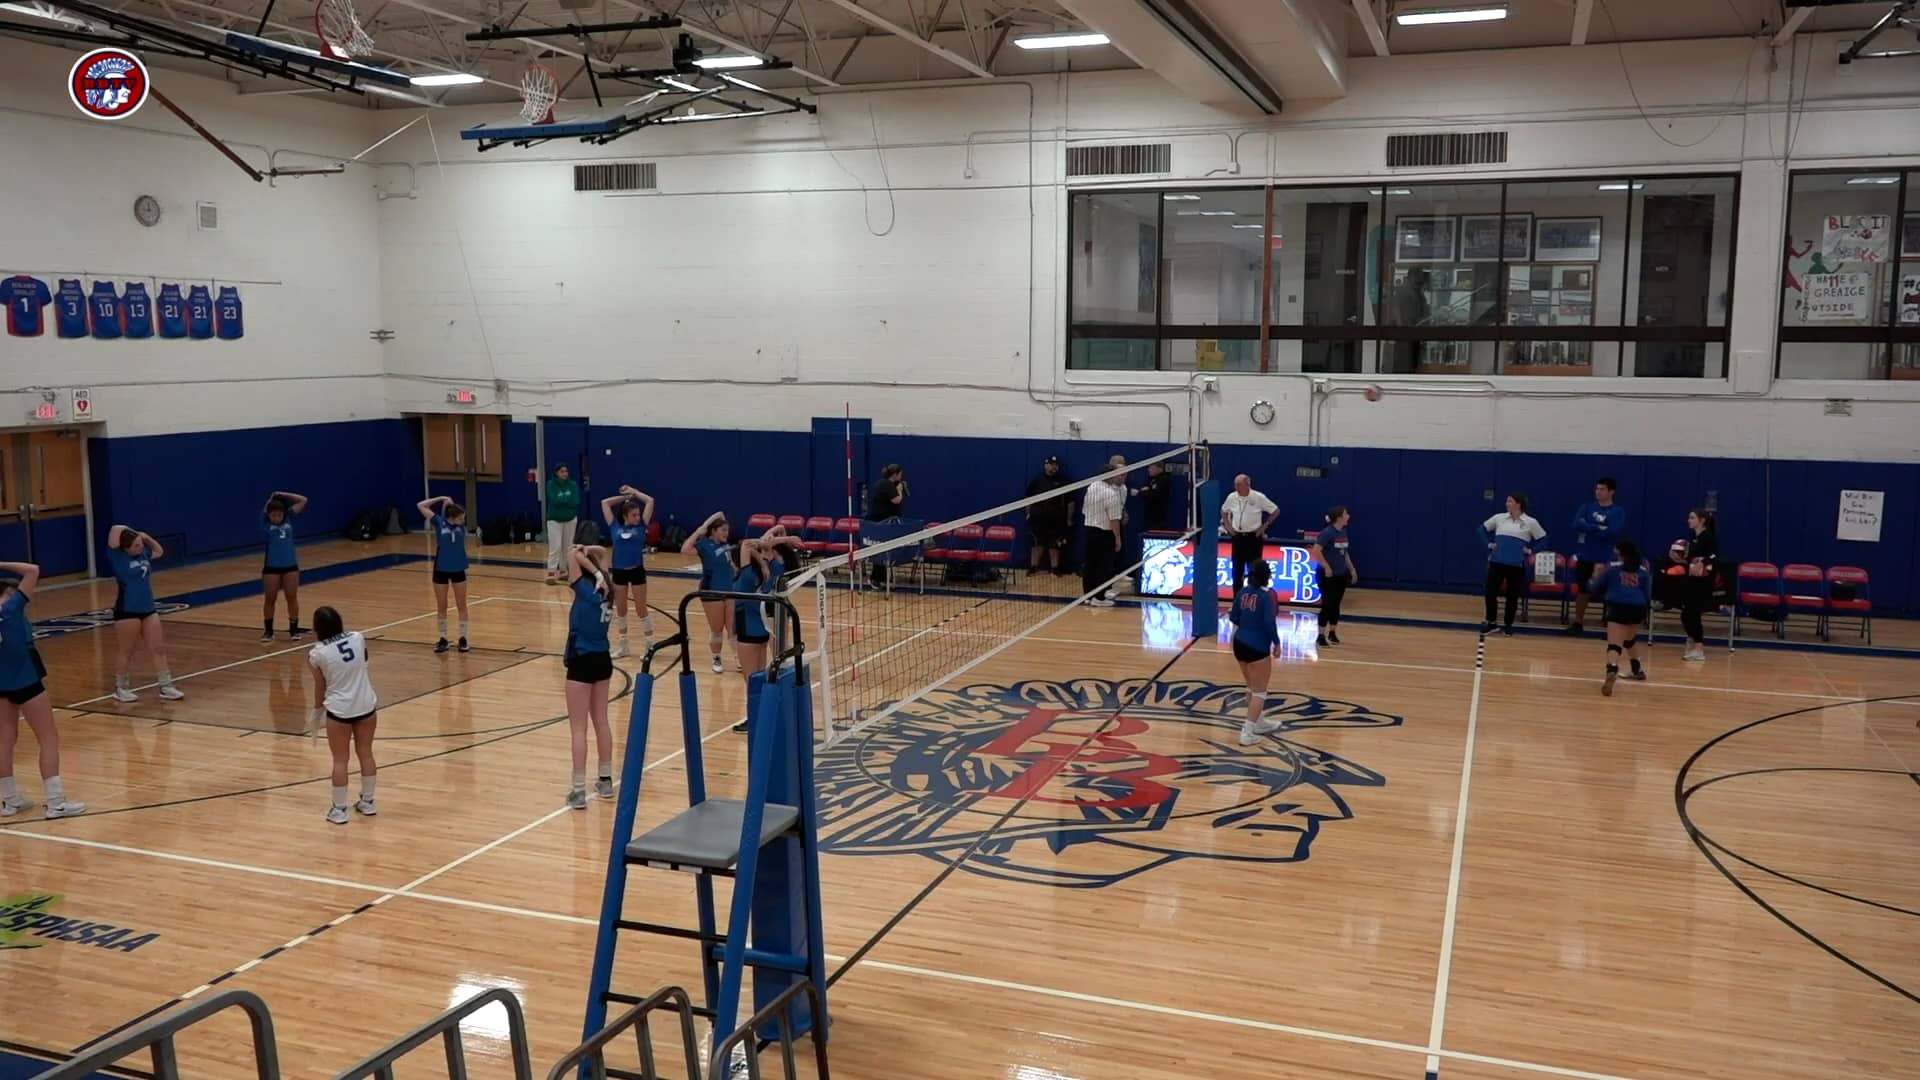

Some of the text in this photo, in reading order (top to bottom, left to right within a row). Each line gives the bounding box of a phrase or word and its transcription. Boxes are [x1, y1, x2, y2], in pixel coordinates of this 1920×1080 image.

[21, 298, 28, 312] 1
[68, 302, 77, 315] 3
[99, 303, 113, 317] 10
[130, 304, 145, 317] 13
[165, 305, 179, 318] 21
[194, 306, 207, 319] 21
[224, 307, 237, 319] 23
[336, 640, 355, 662] 5
